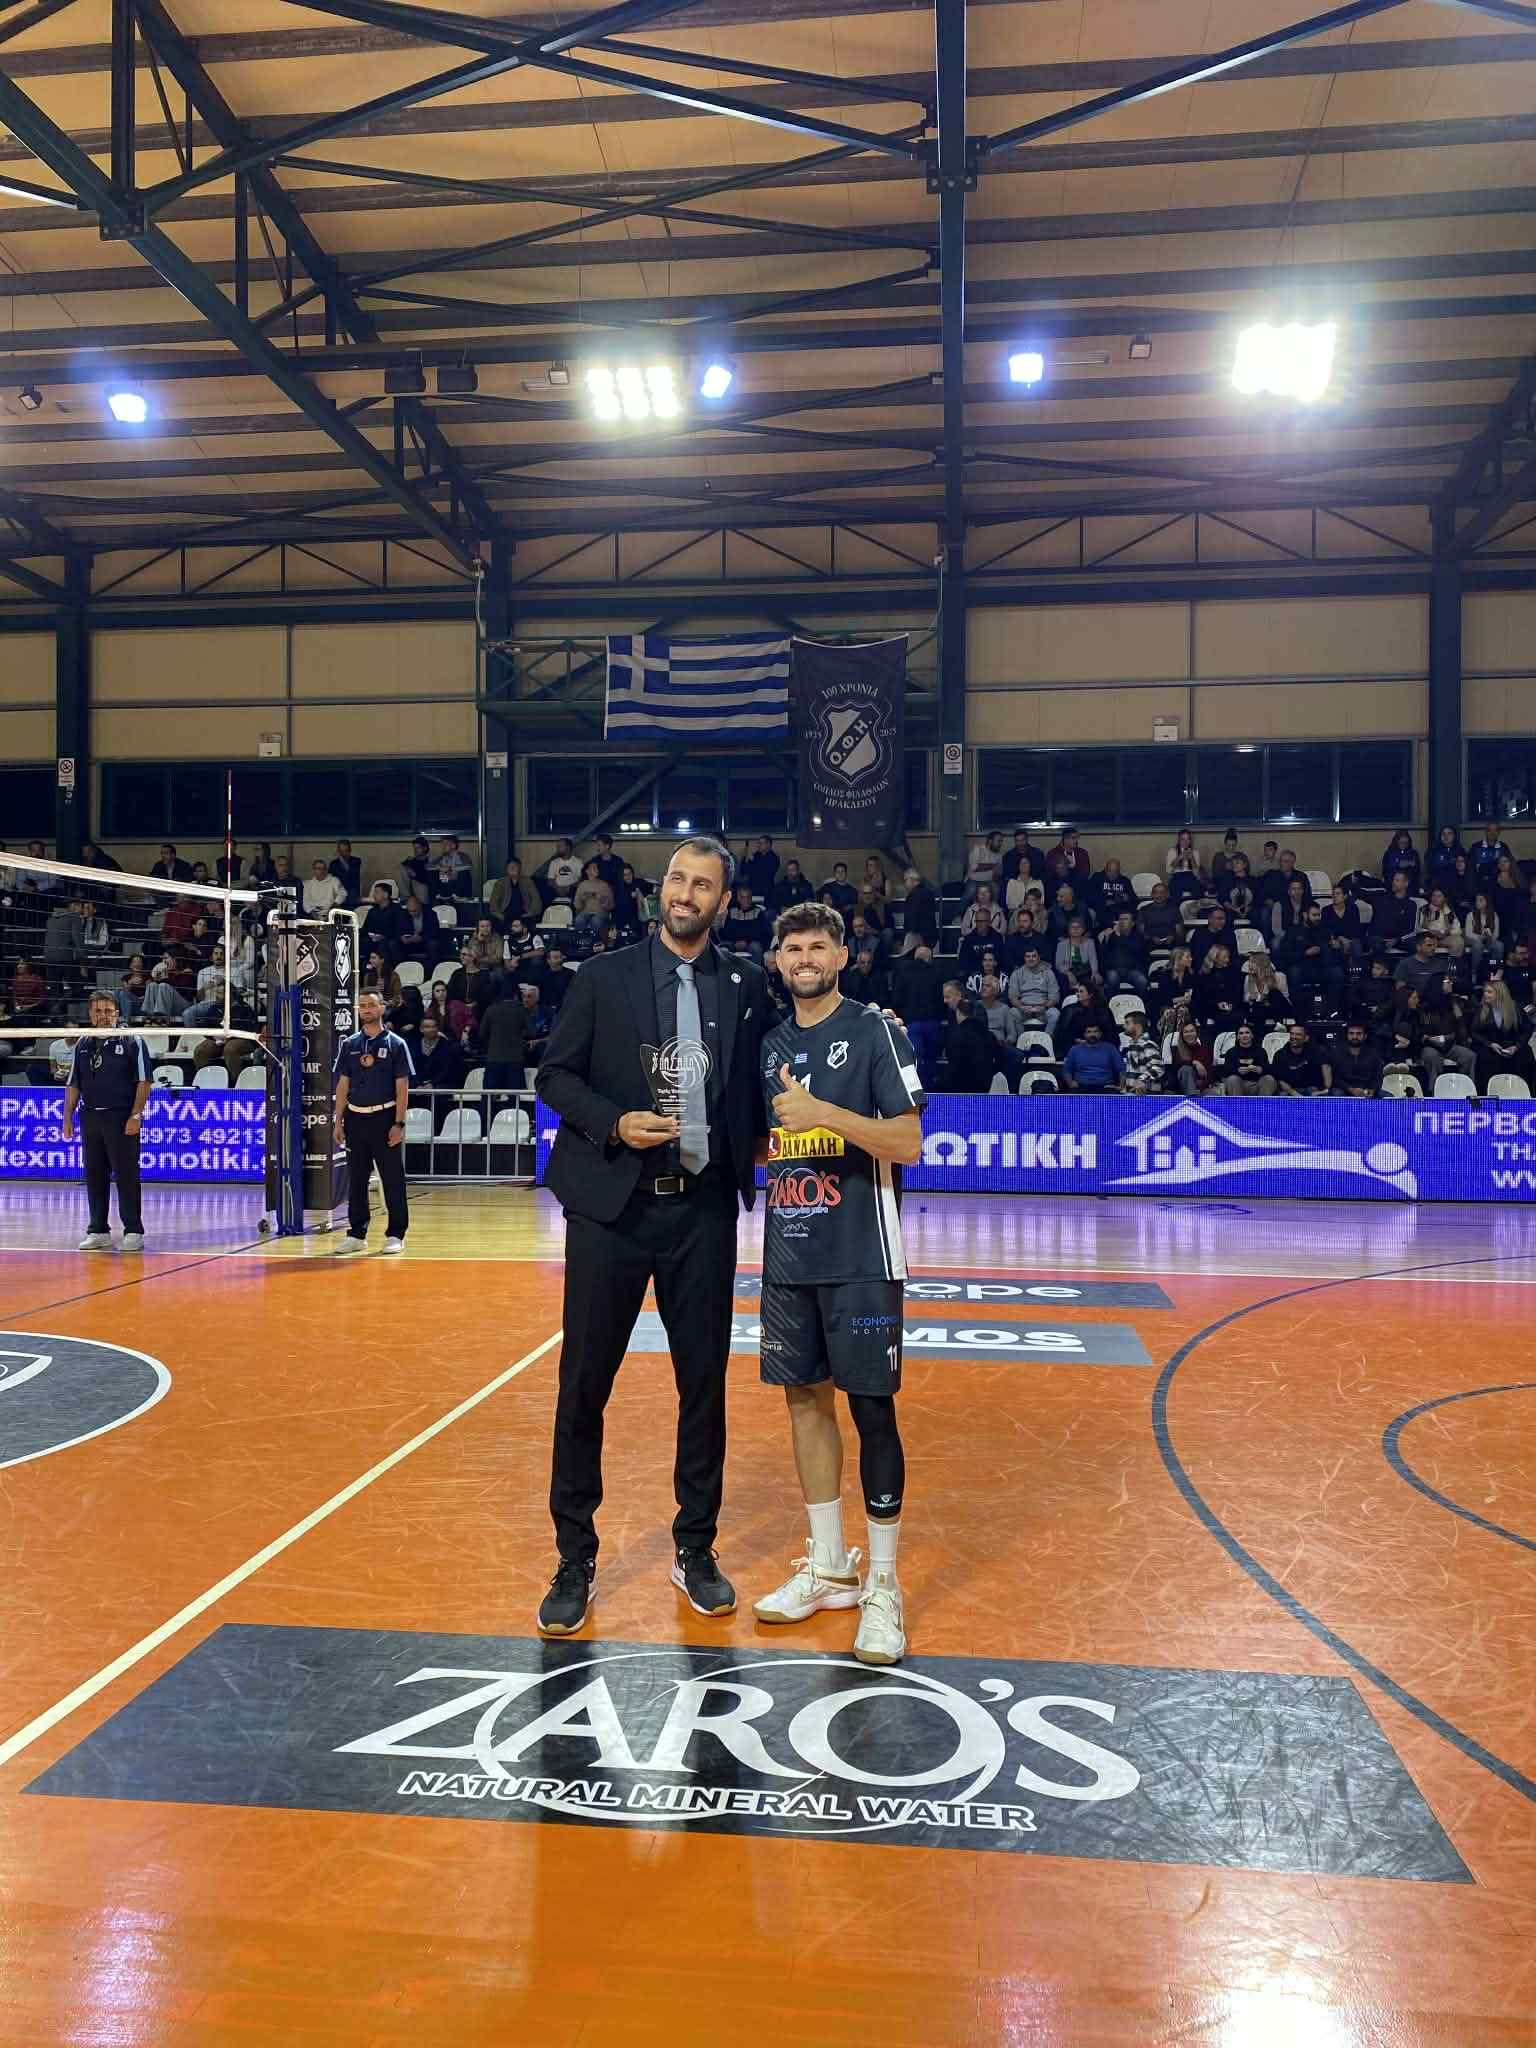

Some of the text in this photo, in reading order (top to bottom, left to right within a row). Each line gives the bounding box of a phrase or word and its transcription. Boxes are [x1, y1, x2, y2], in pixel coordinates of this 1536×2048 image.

[839, 682, 880, 697] ΧΡΟΝΙΑ
[1490, 1142, 1536, 1161] ΤΗ
[332, 1665, 1140, 1803] ZARO'S
[397, 1770, 1038, 1832] NATURAL MINERAL WATER
